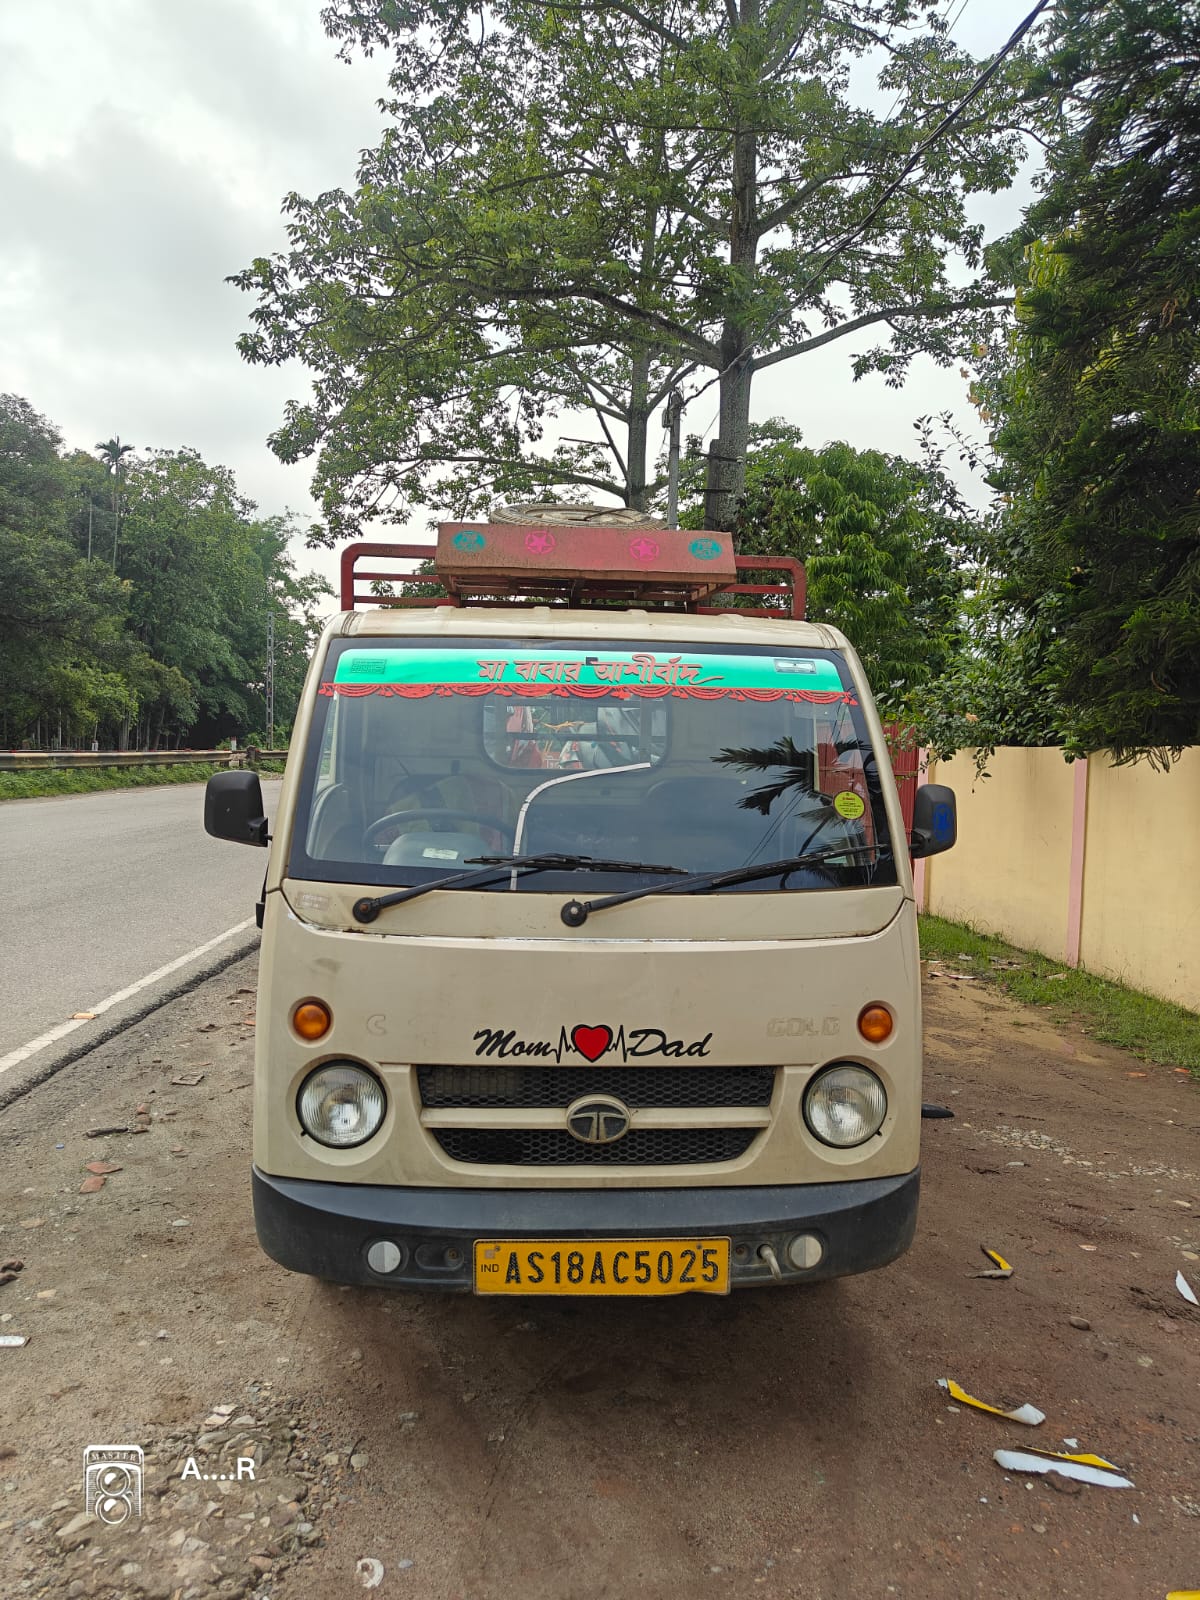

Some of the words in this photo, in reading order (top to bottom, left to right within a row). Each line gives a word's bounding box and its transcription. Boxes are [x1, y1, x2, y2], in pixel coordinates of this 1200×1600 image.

[477, 660, 509, 681] মা
[514, 660, 585, 683] বাবার
[589, 653, 725, 685] আশীর্বাদ
[473, 1028, 552, 1058] Mom
[628, 1028, 713, 1057] Dad
[480, 1263, 500, 1274] IND
[504, 1248, 720, 1285] AS18AC5025
